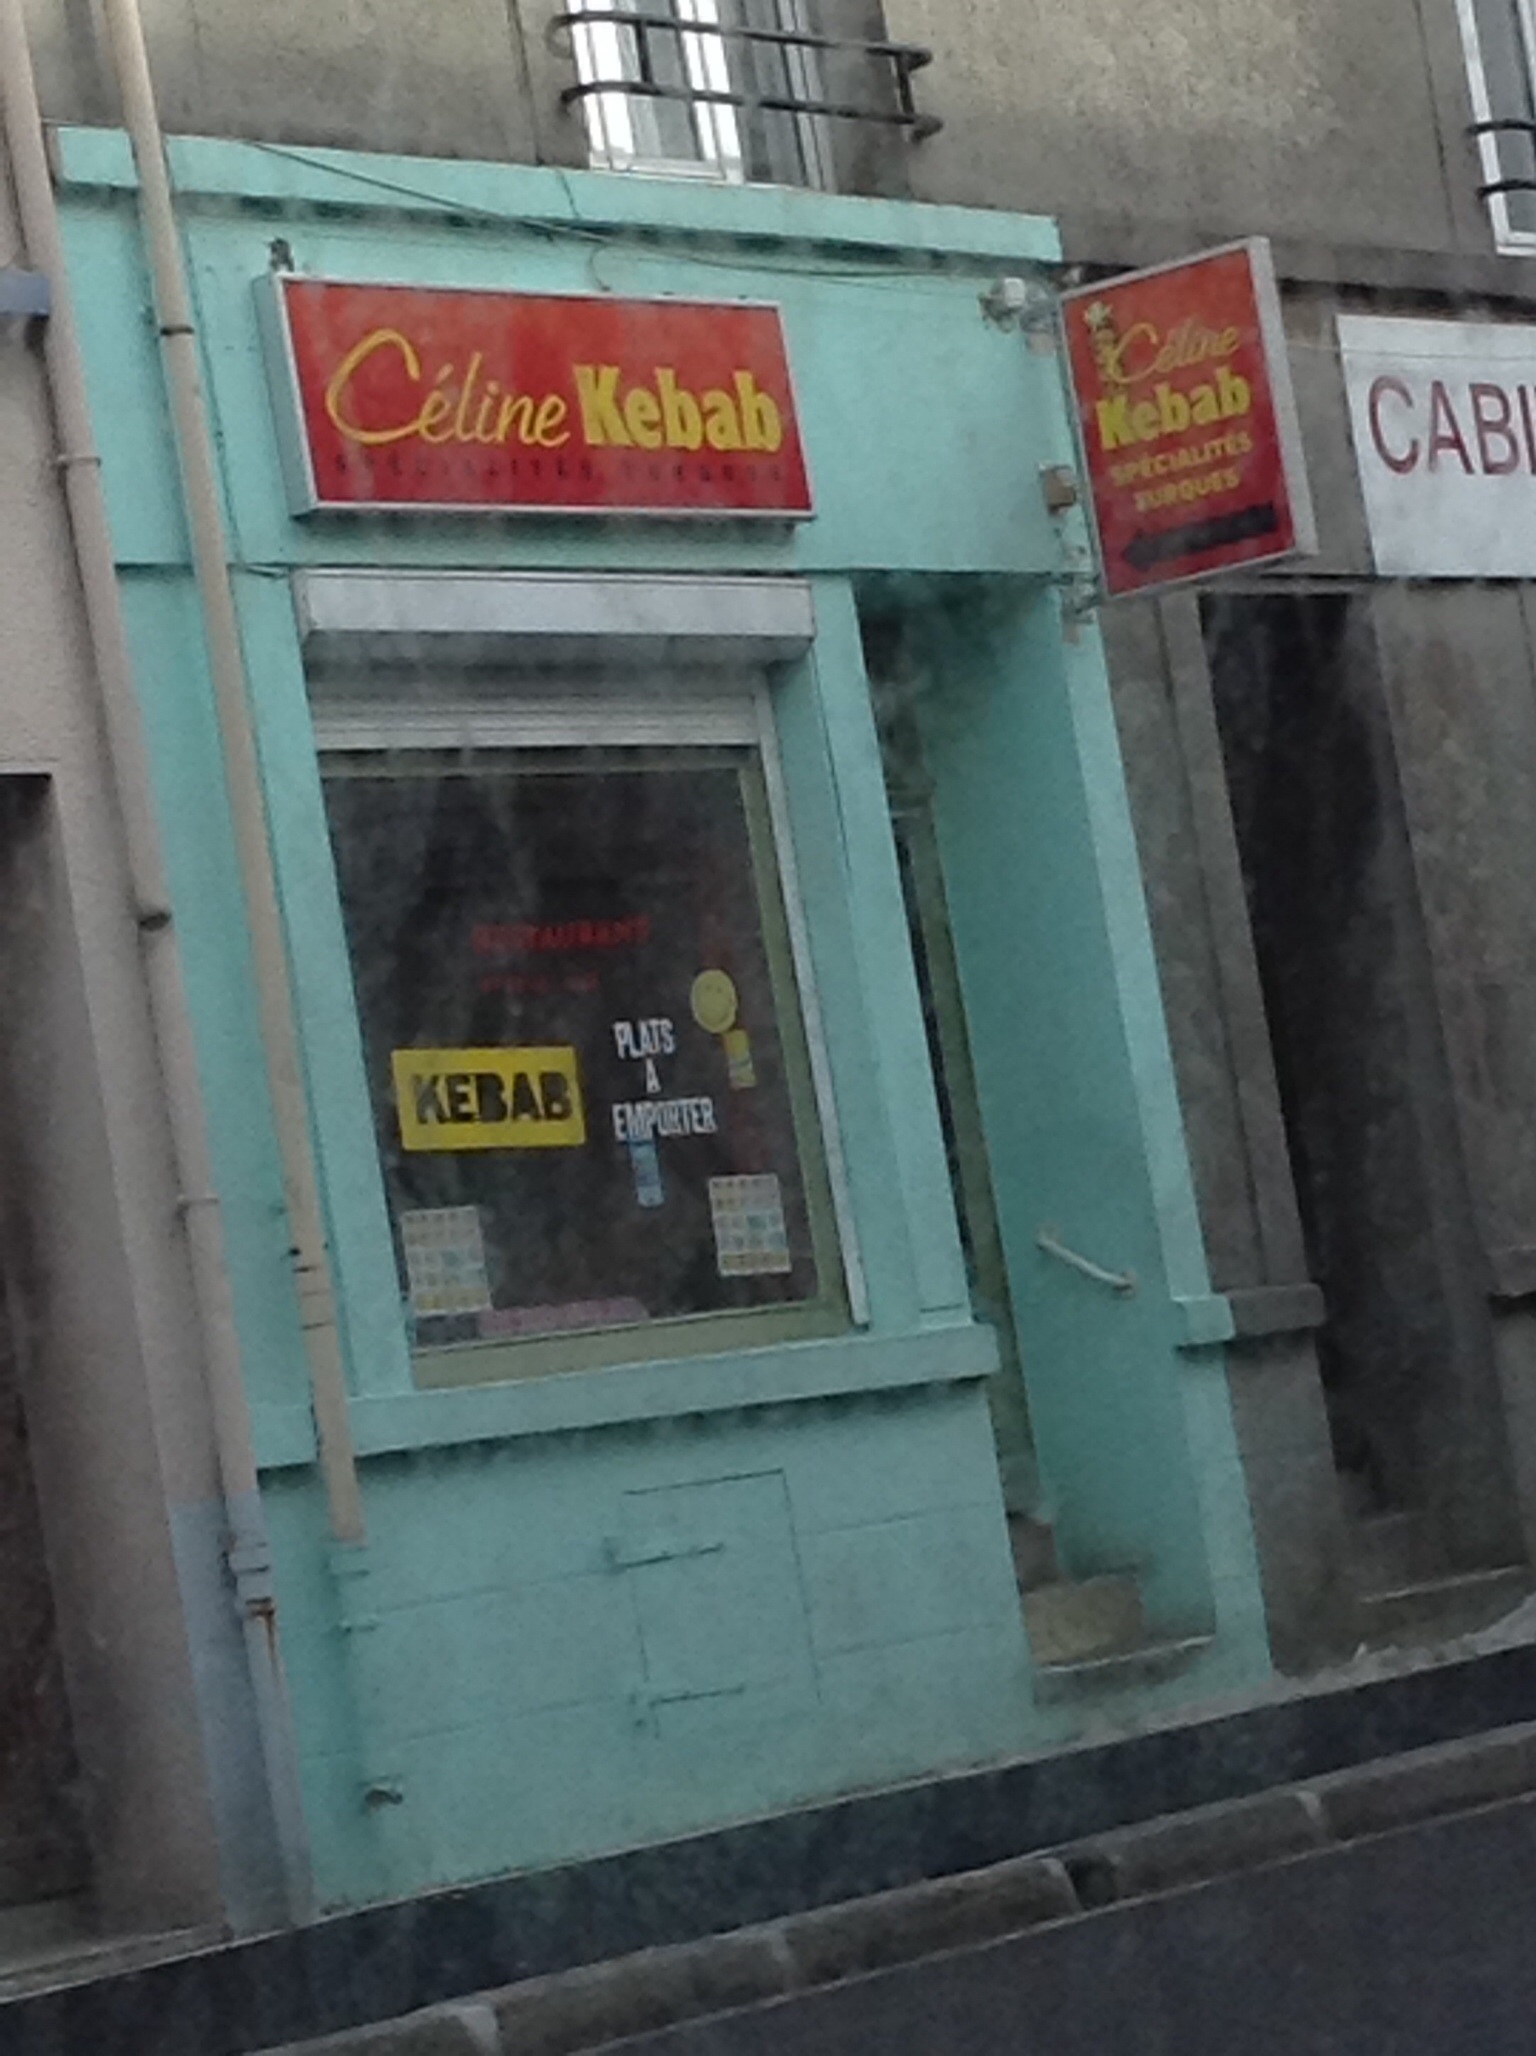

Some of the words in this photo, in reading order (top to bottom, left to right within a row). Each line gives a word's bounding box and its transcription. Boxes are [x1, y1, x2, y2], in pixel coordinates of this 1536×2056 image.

[327, 329, 571, 447] Céline
[574, 364, 782, 452] Kebab
[1096, 366, 1252, 451] Kebab
[1368, 374, 1536, 476] CABI
[1133, 467, 1240, 512] TURQUES
[613, 1018, 676, 1060] PLATS
[411, 1072, 574, 1126] KEBAB
[643, 1058, 662, 1094] A
[612, 1096, 718, 1142] EMPORTER
